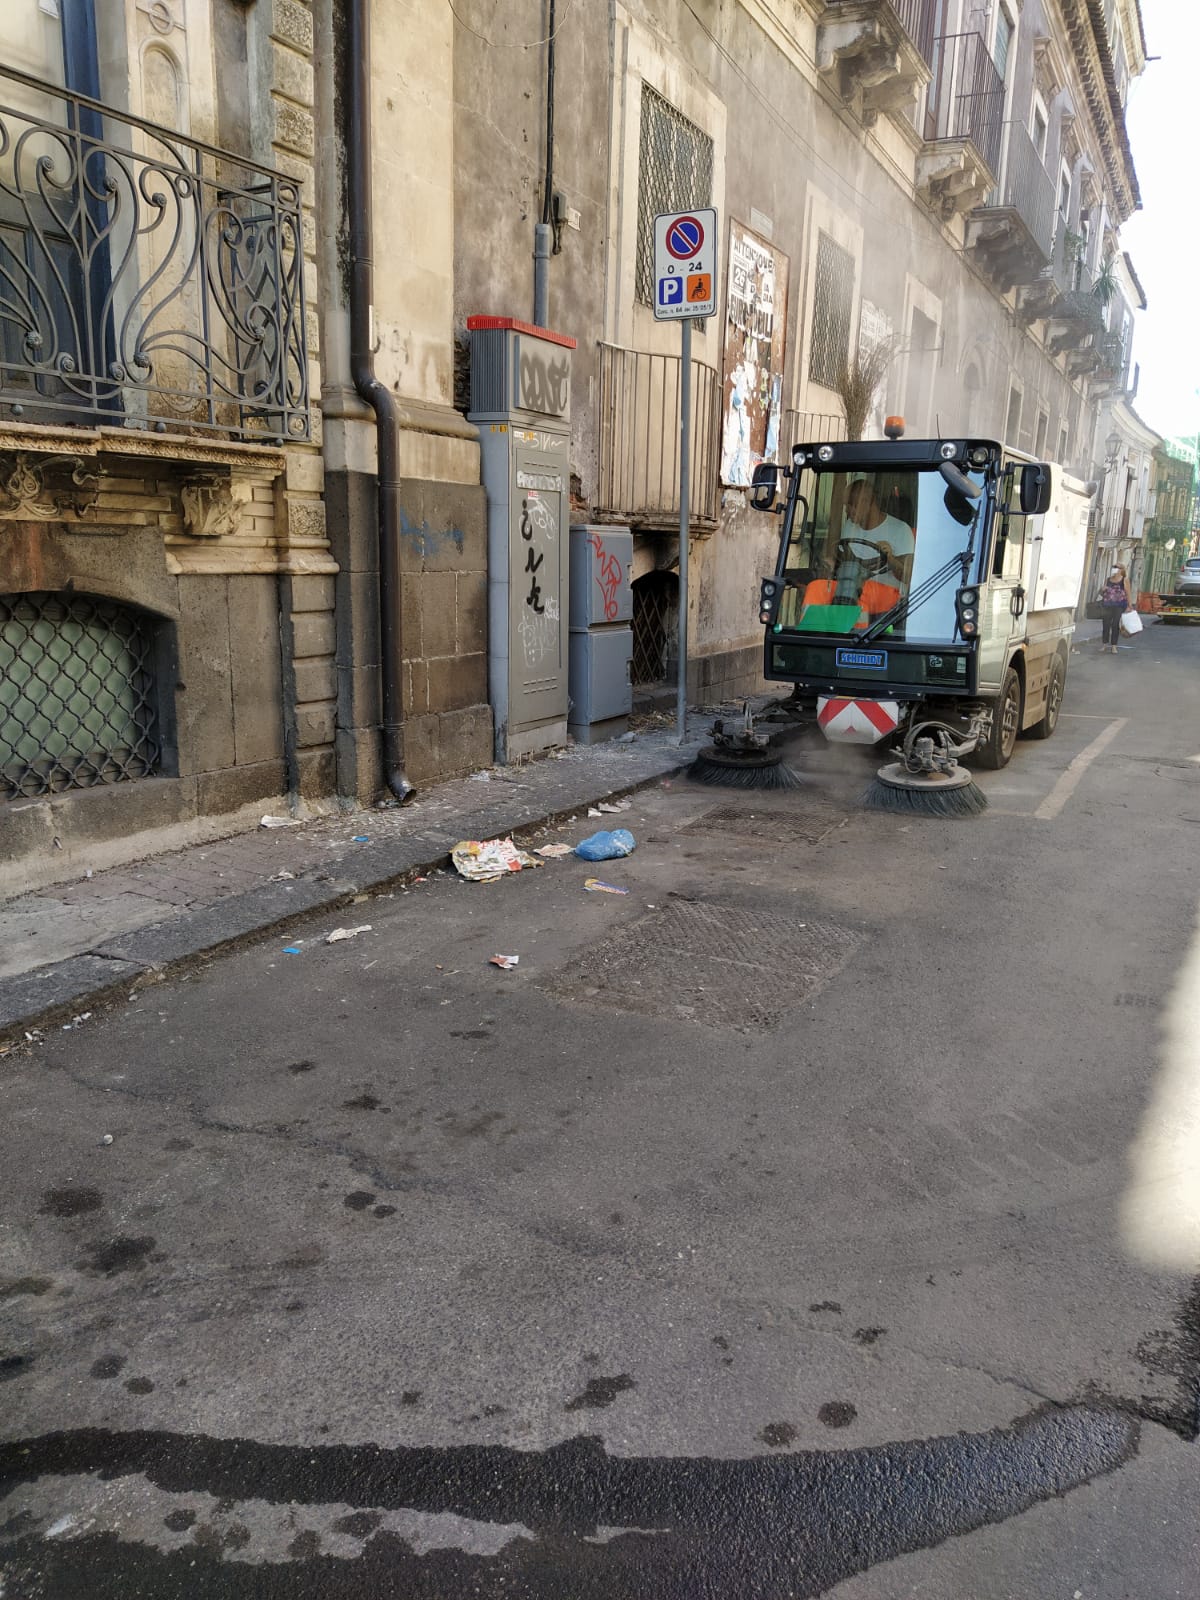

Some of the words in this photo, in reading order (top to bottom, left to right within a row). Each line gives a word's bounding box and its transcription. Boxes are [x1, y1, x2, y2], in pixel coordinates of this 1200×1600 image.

[667, 264, 675, 274] 0
[688, 261, 702, 272] 24
[734, 266, 746, 287] 26
[663, 279, 678, 304] P
[841, 653, 882, 665] SCHMIDT
